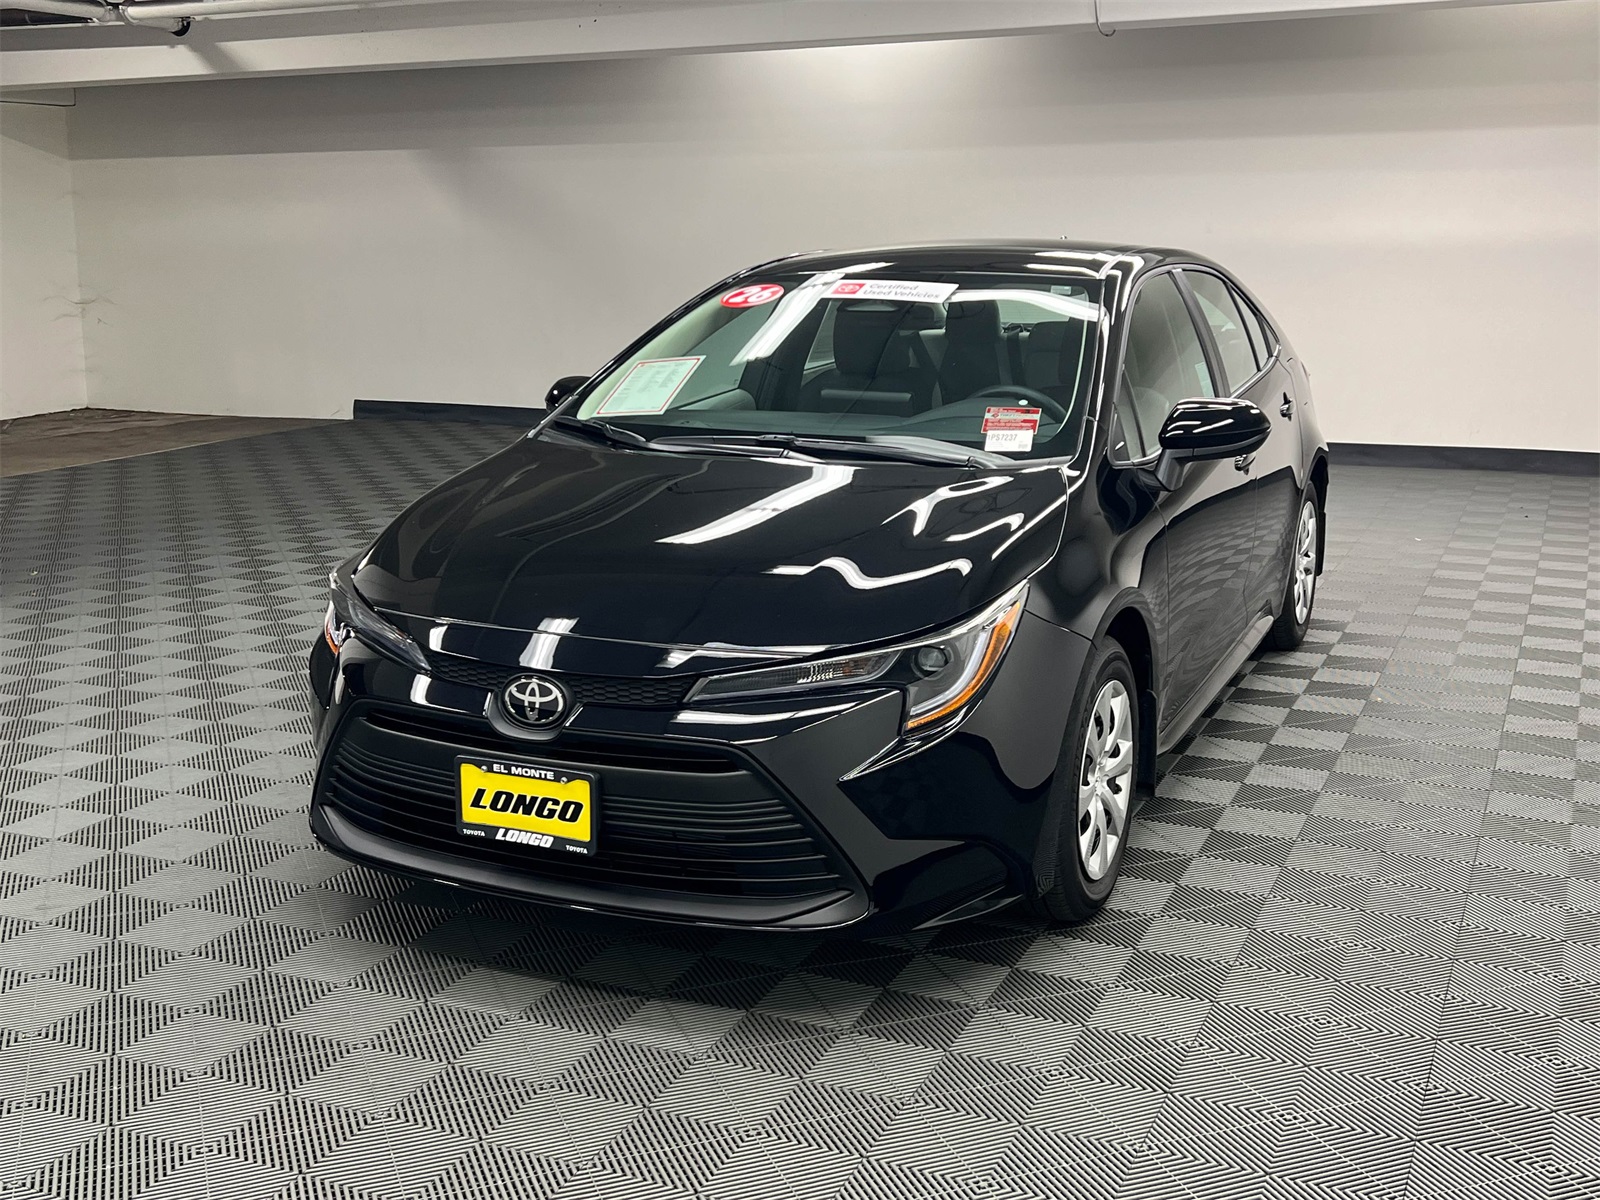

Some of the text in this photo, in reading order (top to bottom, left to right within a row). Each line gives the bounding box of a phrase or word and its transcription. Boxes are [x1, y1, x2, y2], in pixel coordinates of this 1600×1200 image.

[728, 286, 780, 303] 26
[869, 283, 919, 291] Certified
[894, 290, 940, 299] Vehicles
[493, 764, 555, 780] EL MONTE
[470, 788, 584, 823] LONGO
[495, 828, 554, 848] LONGO
[566, 845, 588, 854] TOYOTA
